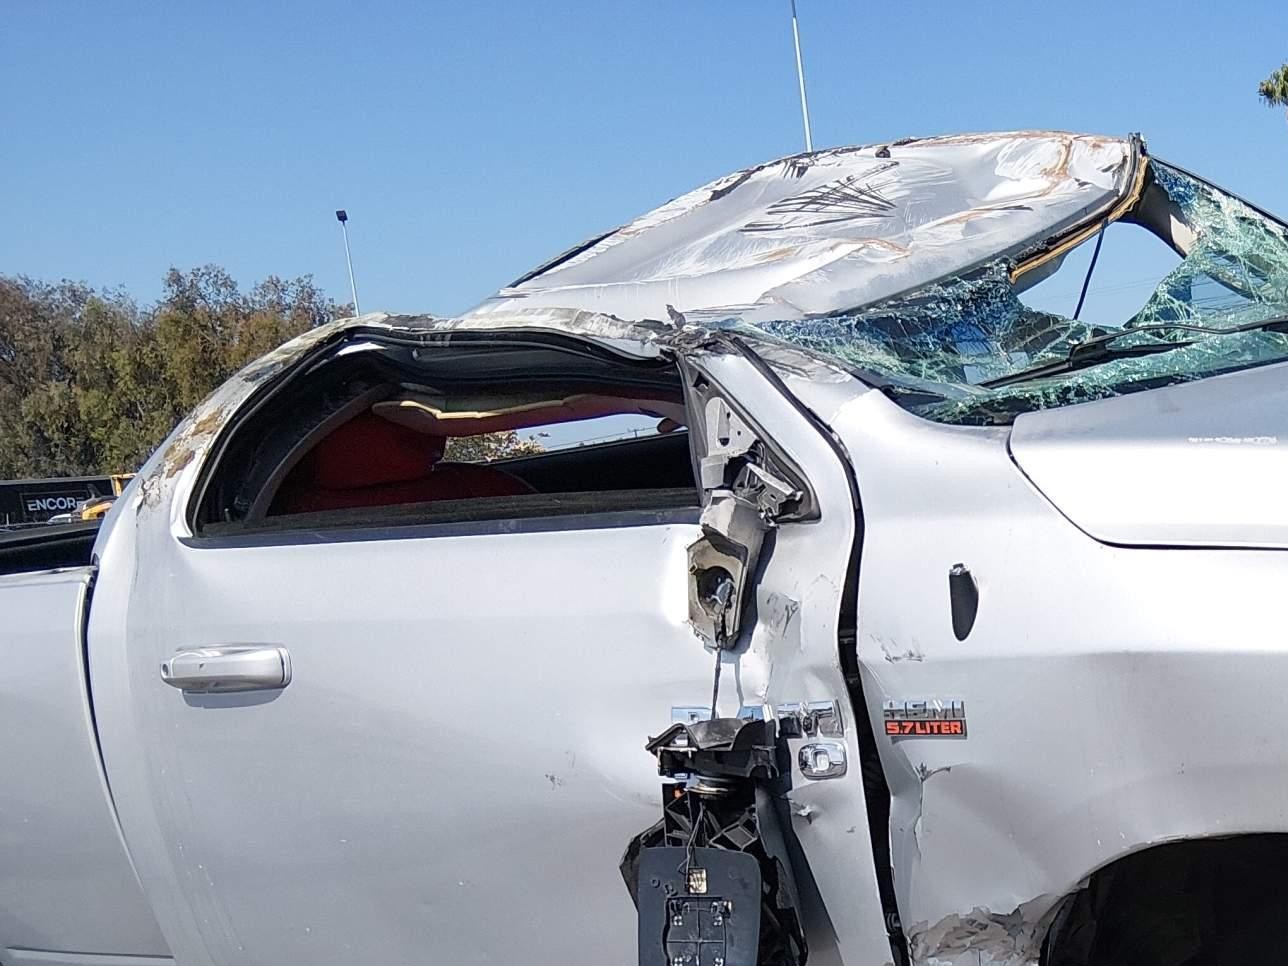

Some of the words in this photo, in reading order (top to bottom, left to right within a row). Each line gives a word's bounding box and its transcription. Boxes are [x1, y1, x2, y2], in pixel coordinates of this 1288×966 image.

[883, 699, 965, 719] HEMI
[886, 721, 914, 734] 5.7
[915, 721, 962, 734] LITER
